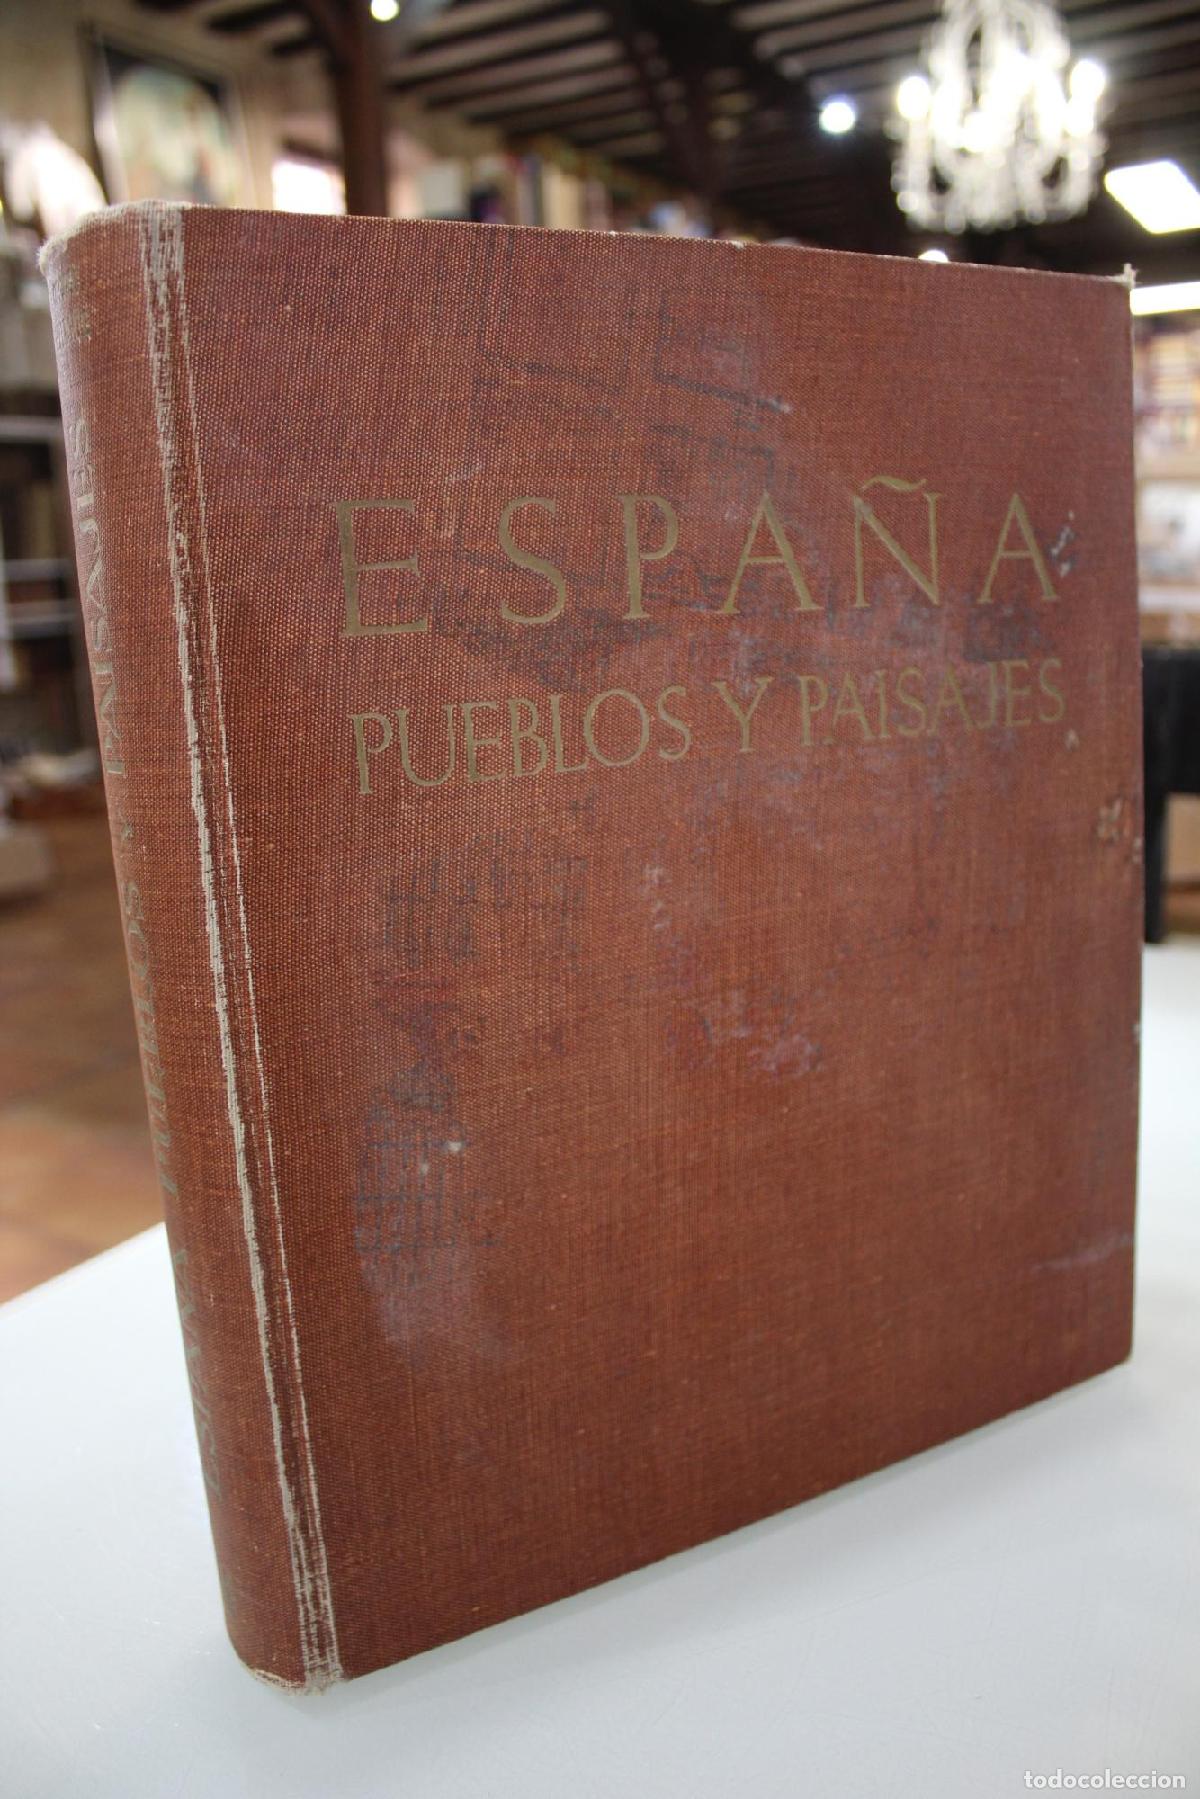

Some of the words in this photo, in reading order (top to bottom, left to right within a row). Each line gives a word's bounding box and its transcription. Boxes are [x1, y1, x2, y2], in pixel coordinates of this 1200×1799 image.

[333, 475, 1061, 640] ESPAÑA
[349, 684, 693, 796] PUEBLOS
[713, 675, 775, 753] Y
[798, 658, 1067, 748] PAISAJES
